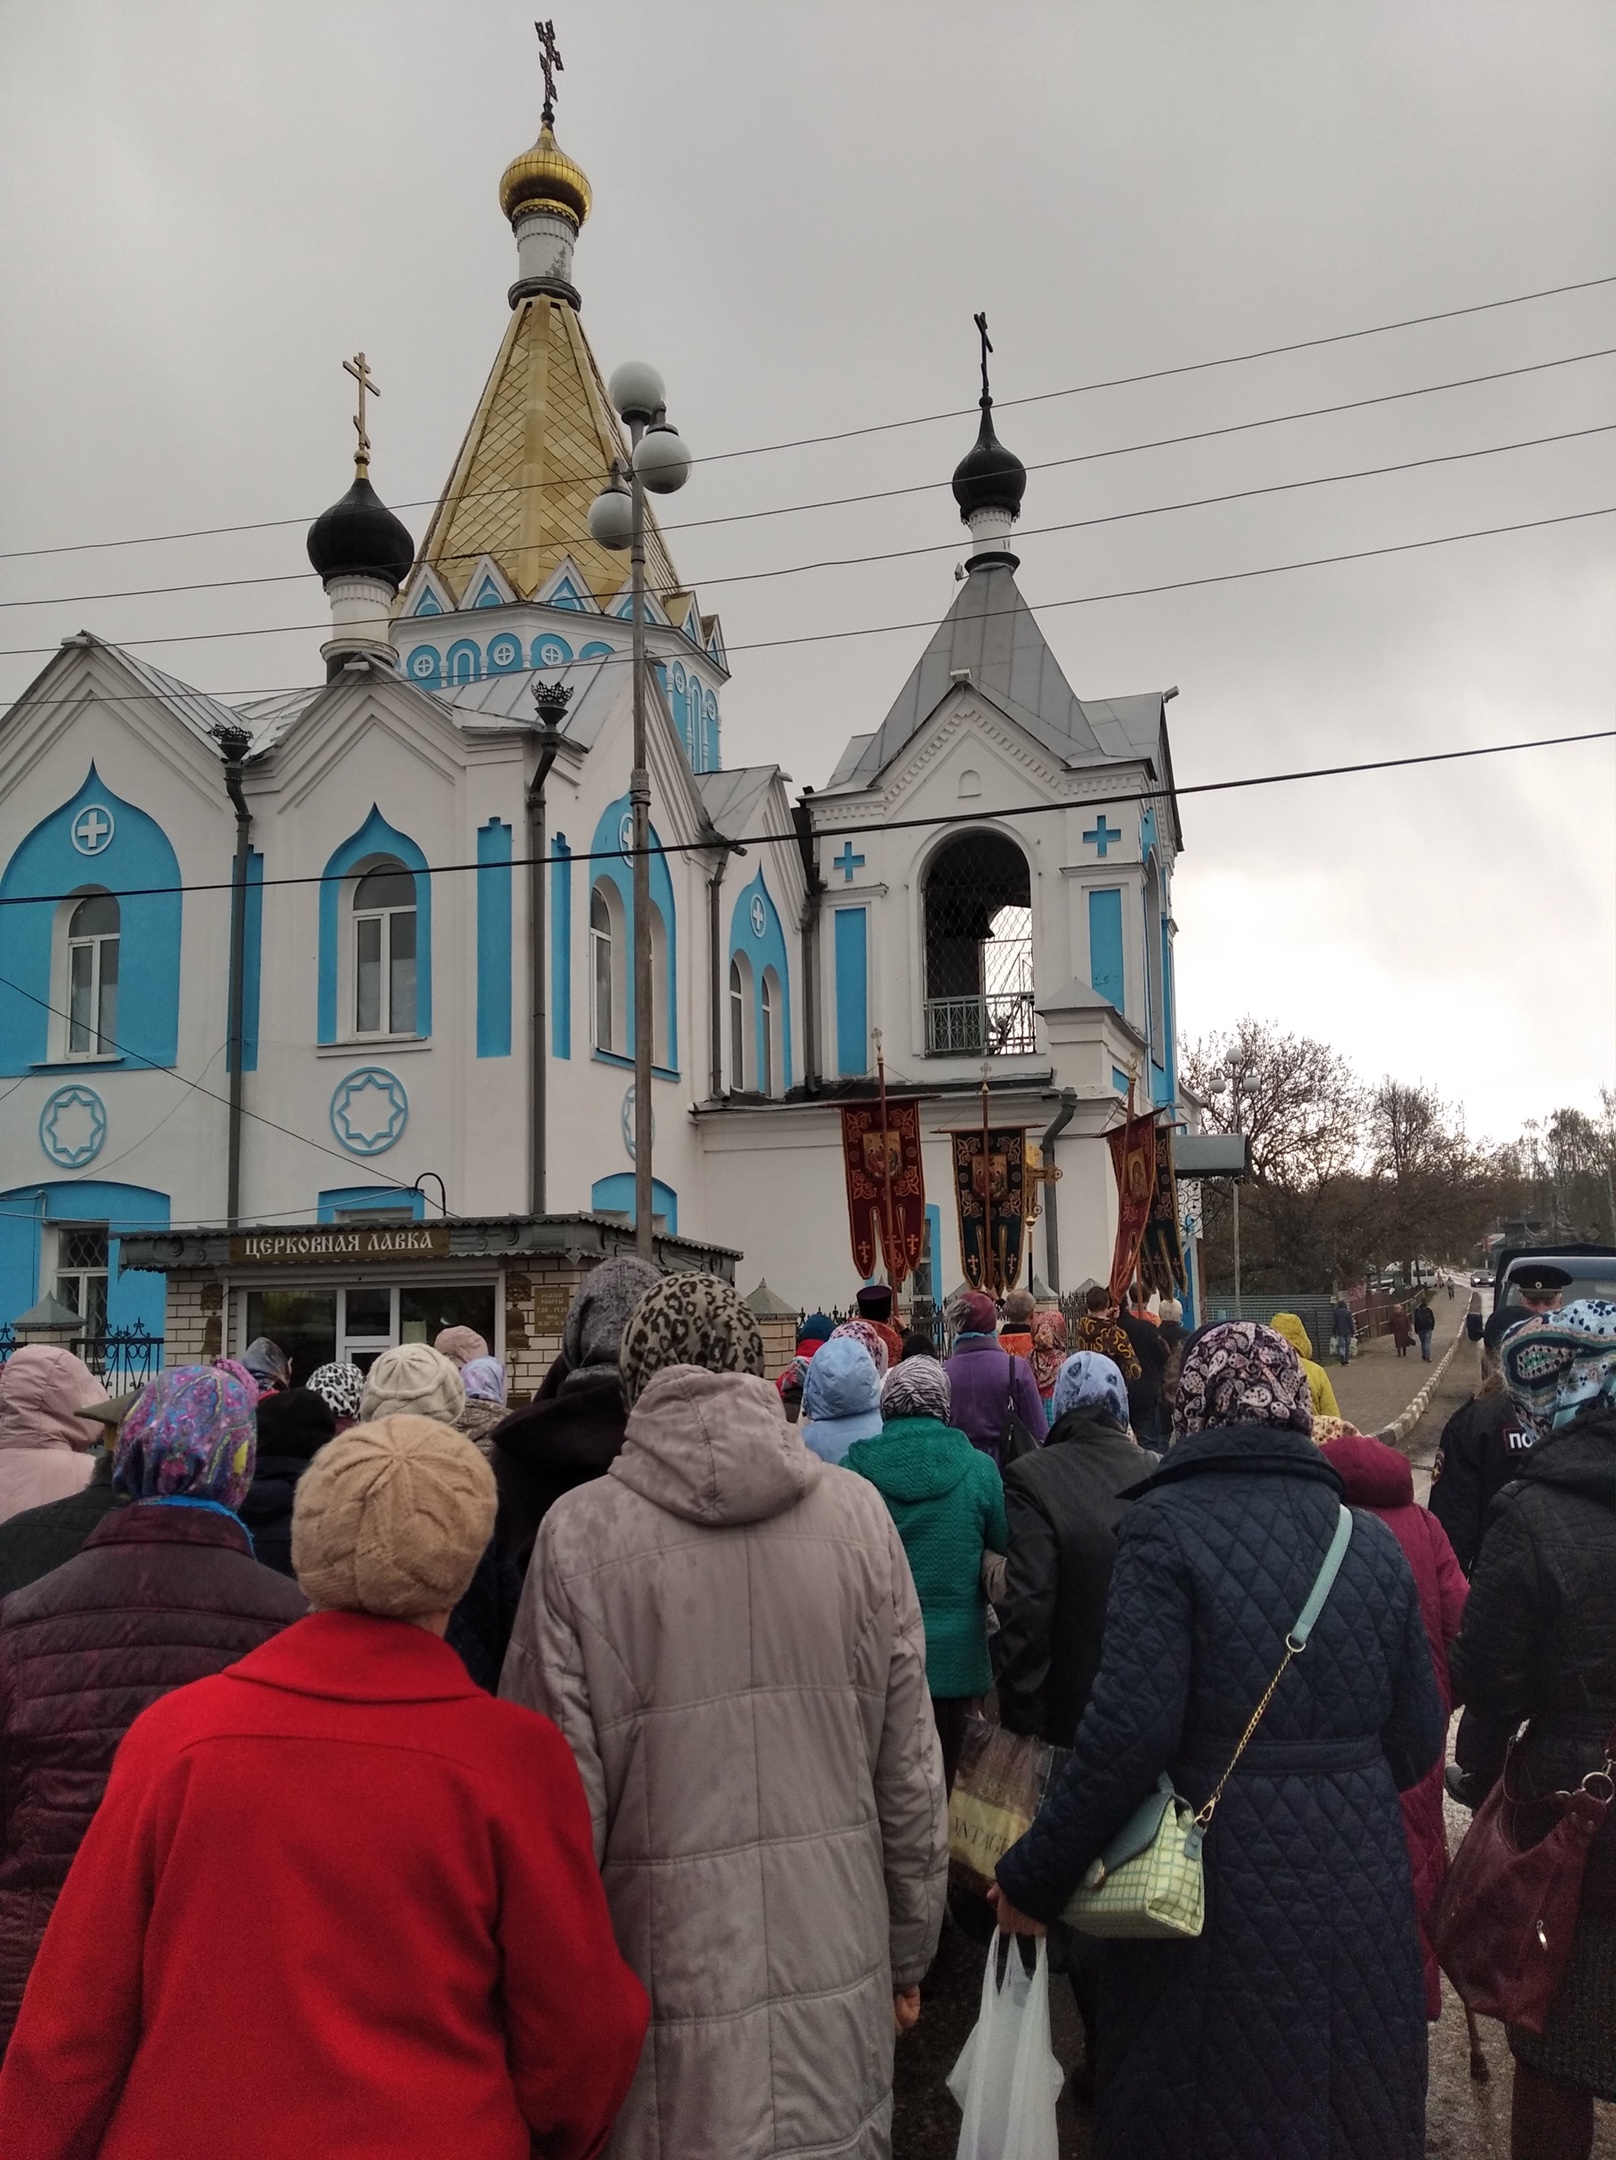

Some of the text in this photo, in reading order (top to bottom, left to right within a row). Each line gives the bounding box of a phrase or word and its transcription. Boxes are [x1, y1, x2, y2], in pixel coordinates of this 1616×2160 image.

[244, 1231, 434, 1260] ЦЕРКОВНАЯ ЛАВКА
[1508, 1432, 1533, 1449] ПО
